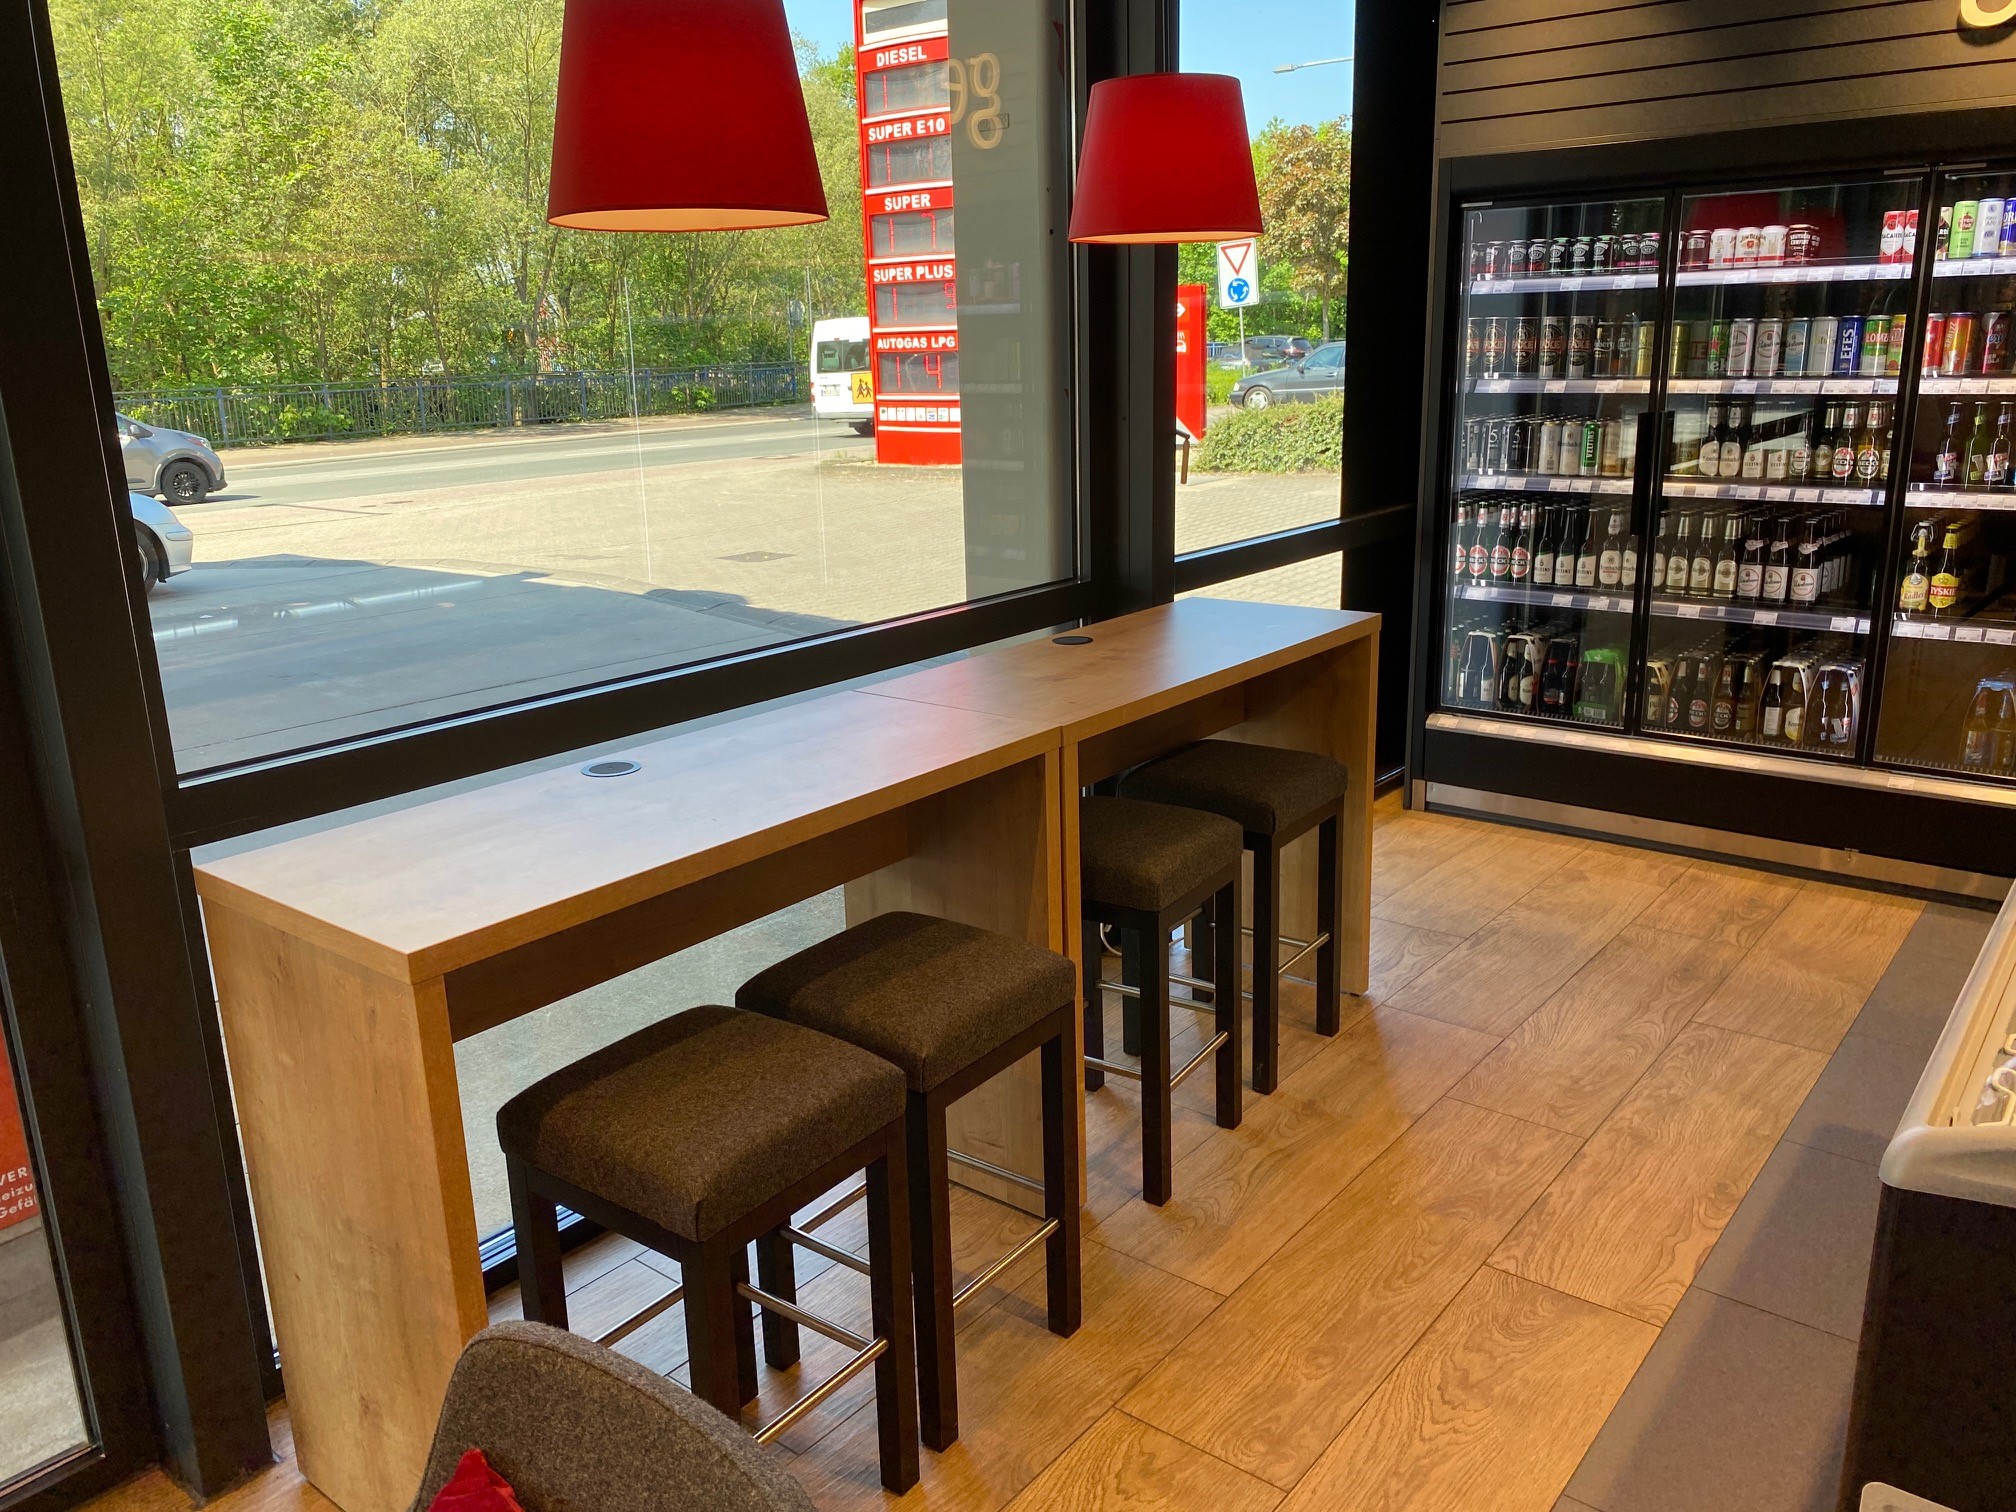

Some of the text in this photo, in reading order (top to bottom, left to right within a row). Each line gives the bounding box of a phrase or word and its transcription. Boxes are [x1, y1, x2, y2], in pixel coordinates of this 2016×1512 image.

[876, 46, 927, 67] DIESEL
[868, 117, 946, 142] SUPER E10
[884, 193, 931, 211] SUPER
[874, 264, 954, 282] SUPER PLUS
[877, 336, 955, 350] AUTOGAS LPG
[1841, 328, 1854, 359] EFES
[1586, 430, 1595, 458] VELTINS
[1904, 590, 1925, 600] Radler
[1931, 586, 1957, 596] TYSKIE
[0, 1183, 33, 1202] eizu
